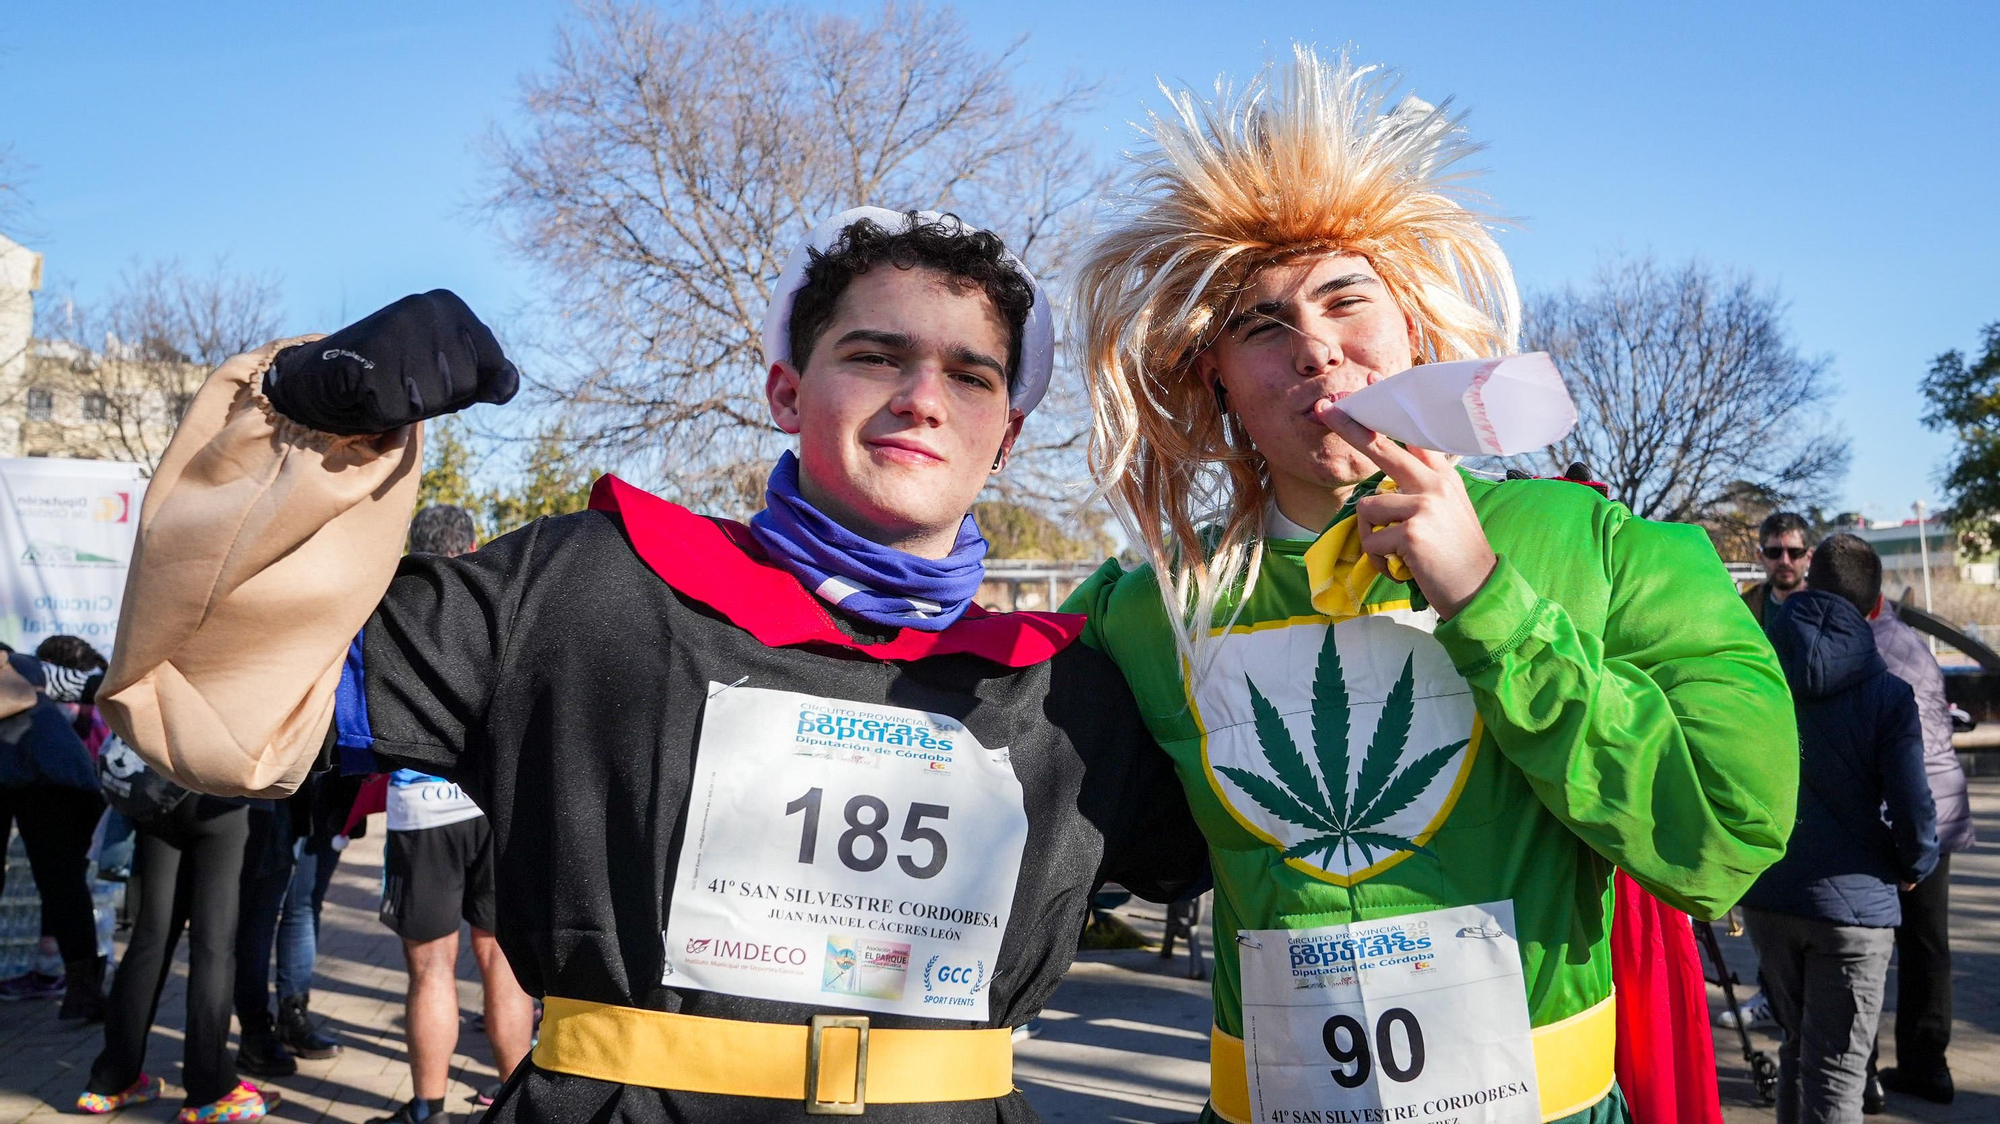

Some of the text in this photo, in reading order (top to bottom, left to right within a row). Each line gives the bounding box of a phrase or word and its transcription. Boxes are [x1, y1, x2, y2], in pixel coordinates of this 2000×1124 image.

[800, 702, 929, 728] CIRCUITO PROVINCIAL
[934, 722, 954, 732] 20
[797, 719, 954, 751] populares
[795, 735, 952, 763] Diputación de Córdoba
[785, 786, 950, 880] 185
[739, 881, 780, 900] SAN
[784, 888, 893, 914] SILVESTRE
[898, 901, 998, 929] CORDOBESA
[768, 909, 962, 941] JUAN MANUEL CÁCERES LEÓN
[1288, 924, 1405, 945] CIRCUITO PROVINCIAL
[1406, 921, 1429, 930] 20
[1407, 929, 1430, 939] 25
[713, 939, 806, 966] IMDECO
[1289, 930, 1407, 956] carreras
[1290, 937, 1432, 968] populares
[865, 951, 907, 965] EL PARQUE
[1292, 953, 1435, 978] Diputación de Córdoba
[938, 965, 972, 984] GCC
[923, 995, 974, 1006] SPORT EVENTS
[1322, 1007, 1425, 1089] 90
[1293, 1110, 1322, 1124] SAN
[1325, 1104, 1419, 1124] SILVESTRE
[1423, 1081, 1529, 1115] CORDOBESA
